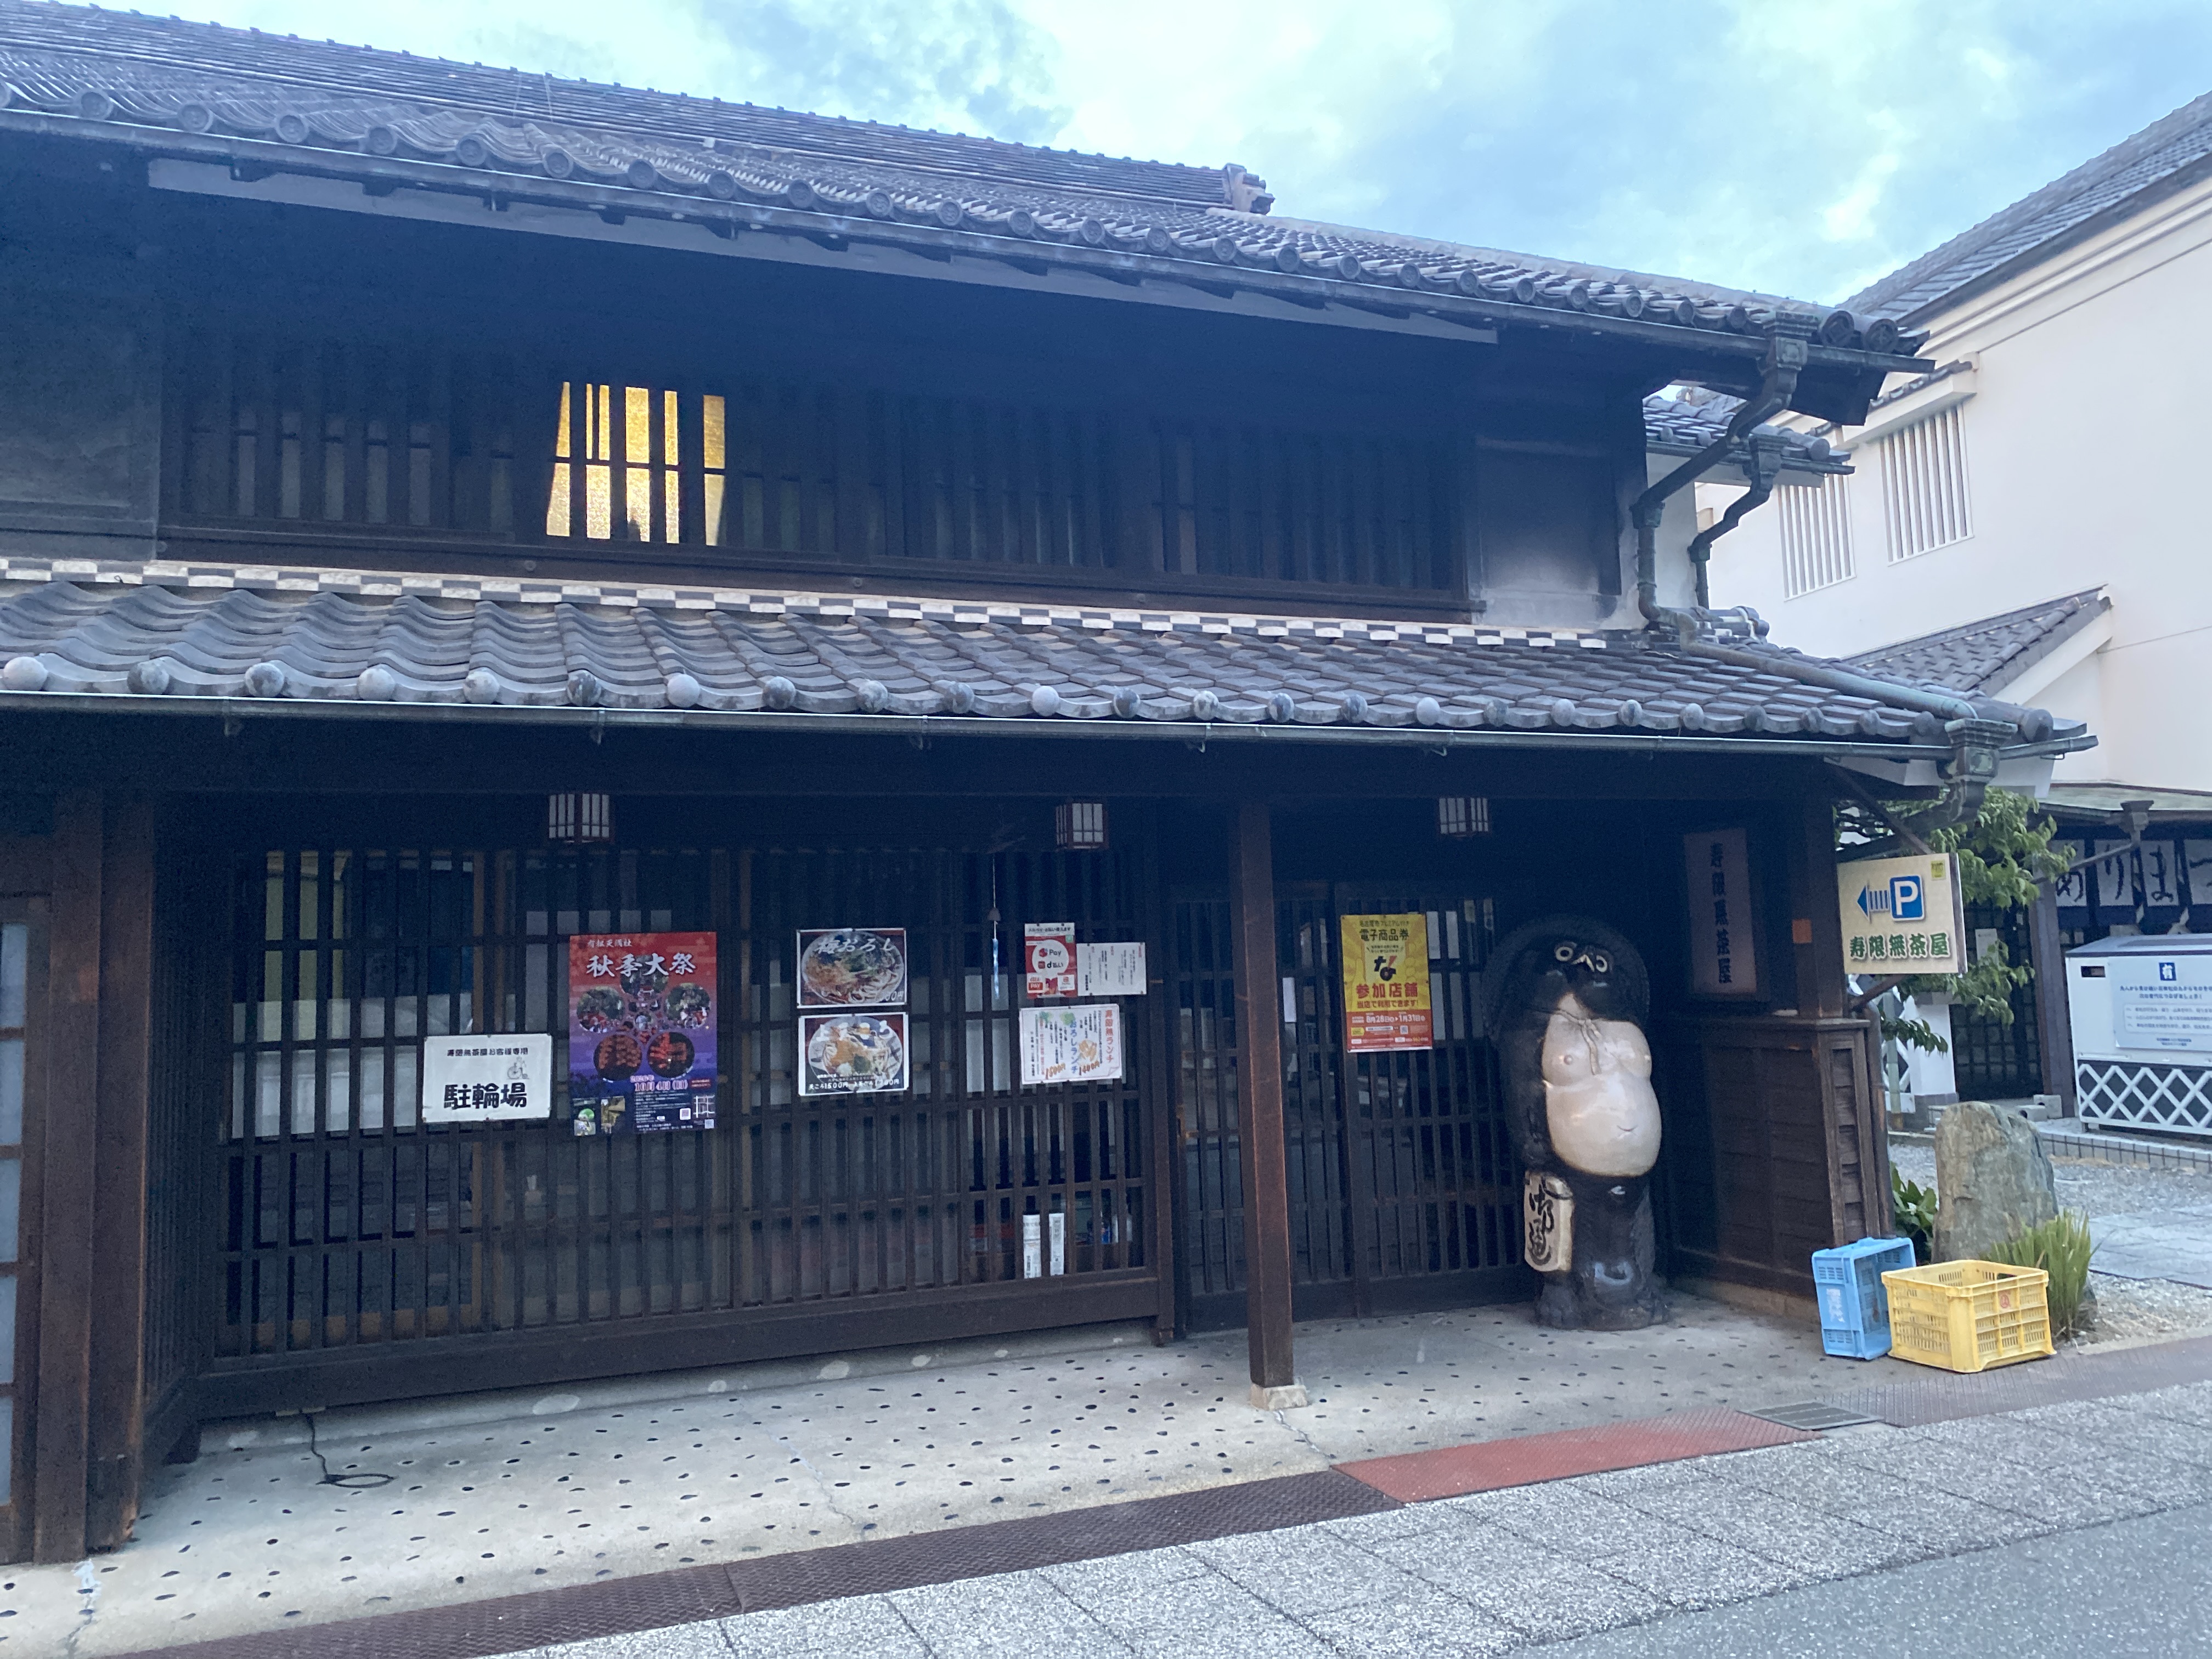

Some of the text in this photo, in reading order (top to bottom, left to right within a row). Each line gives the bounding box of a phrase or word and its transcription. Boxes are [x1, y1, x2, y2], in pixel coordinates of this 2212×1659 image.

[1894, 881, 1918, 916] P
[815, 938, 894, 954] 梅おろし
[1359, 929, 1409, 941] 電子商品券
[1850, 933, 1949, 958] 寿限無茶屋
[586, 952, 696, 978] 秋季大祭
[1356, 983, 1418, 999] 参加店舗
[443, 1082, 527, 1110] 駐輪場
